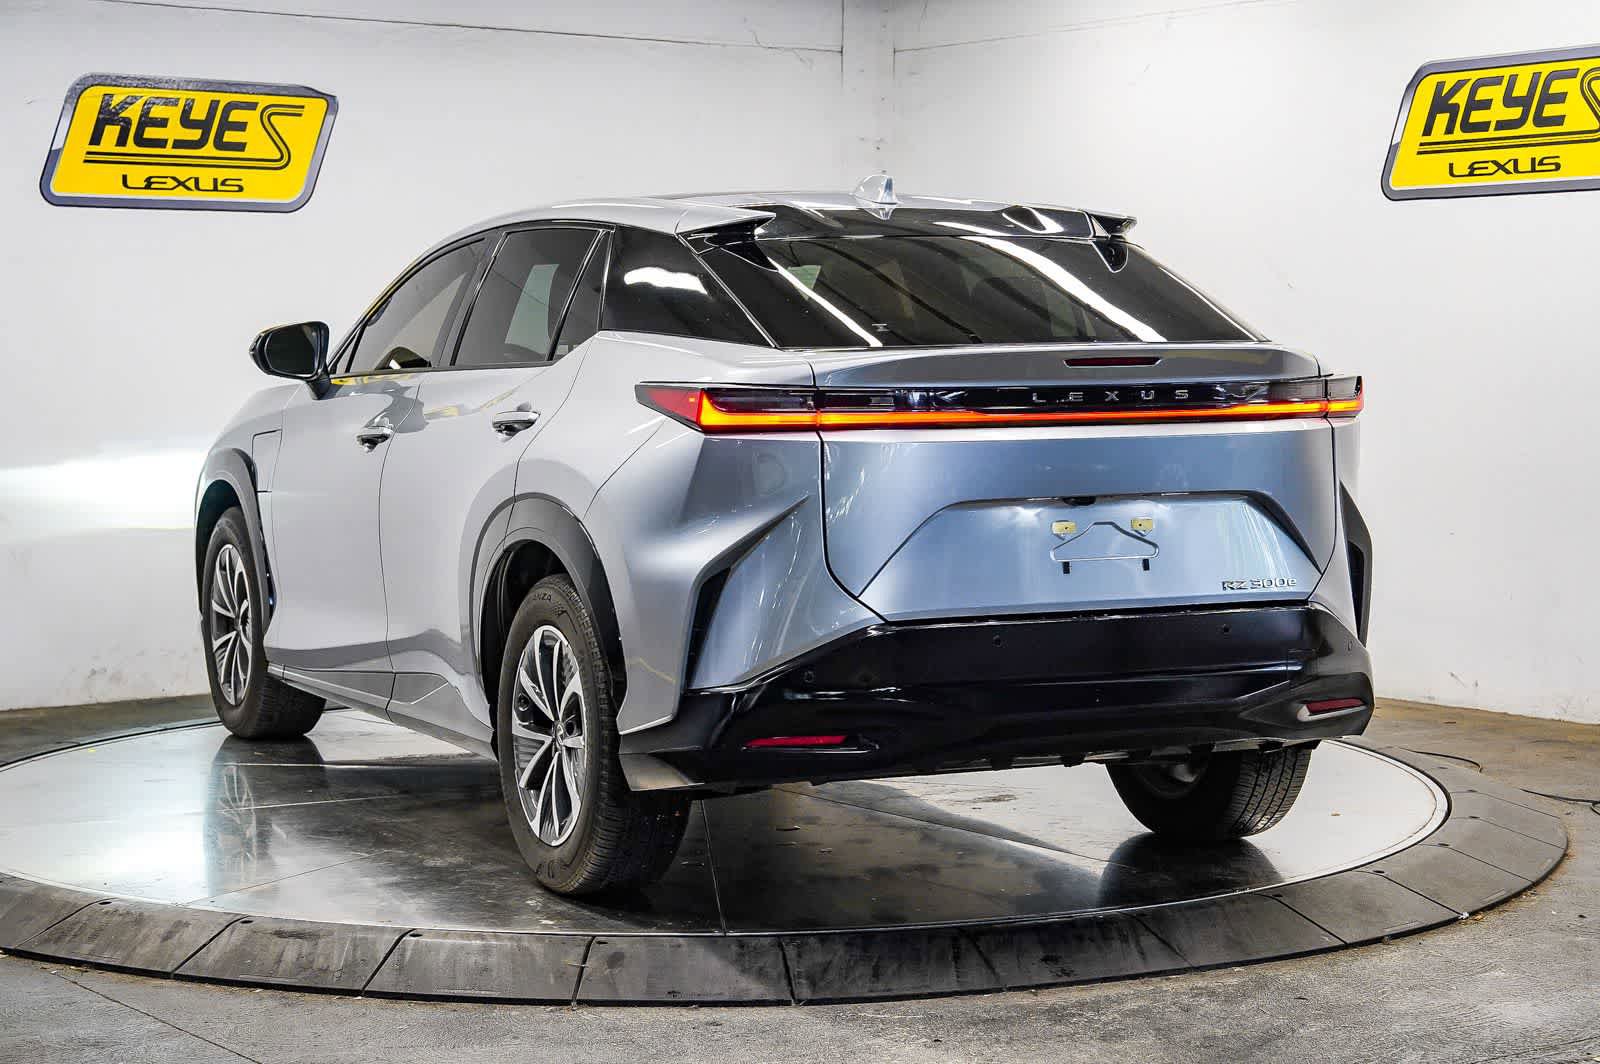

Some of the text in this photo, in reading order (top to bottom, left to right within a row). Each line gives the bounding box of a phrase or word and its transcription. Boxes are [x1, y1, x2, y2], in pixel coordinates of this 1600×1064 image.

[87, 93, 305, 170] KEYES
[1449, 156, 1561, 178] LEXUS
[122, 174, 245, 193] LEXUS
[1032, 389, 1189, 403] LEXUS
[1221, 580, 1248, 591] RZ
